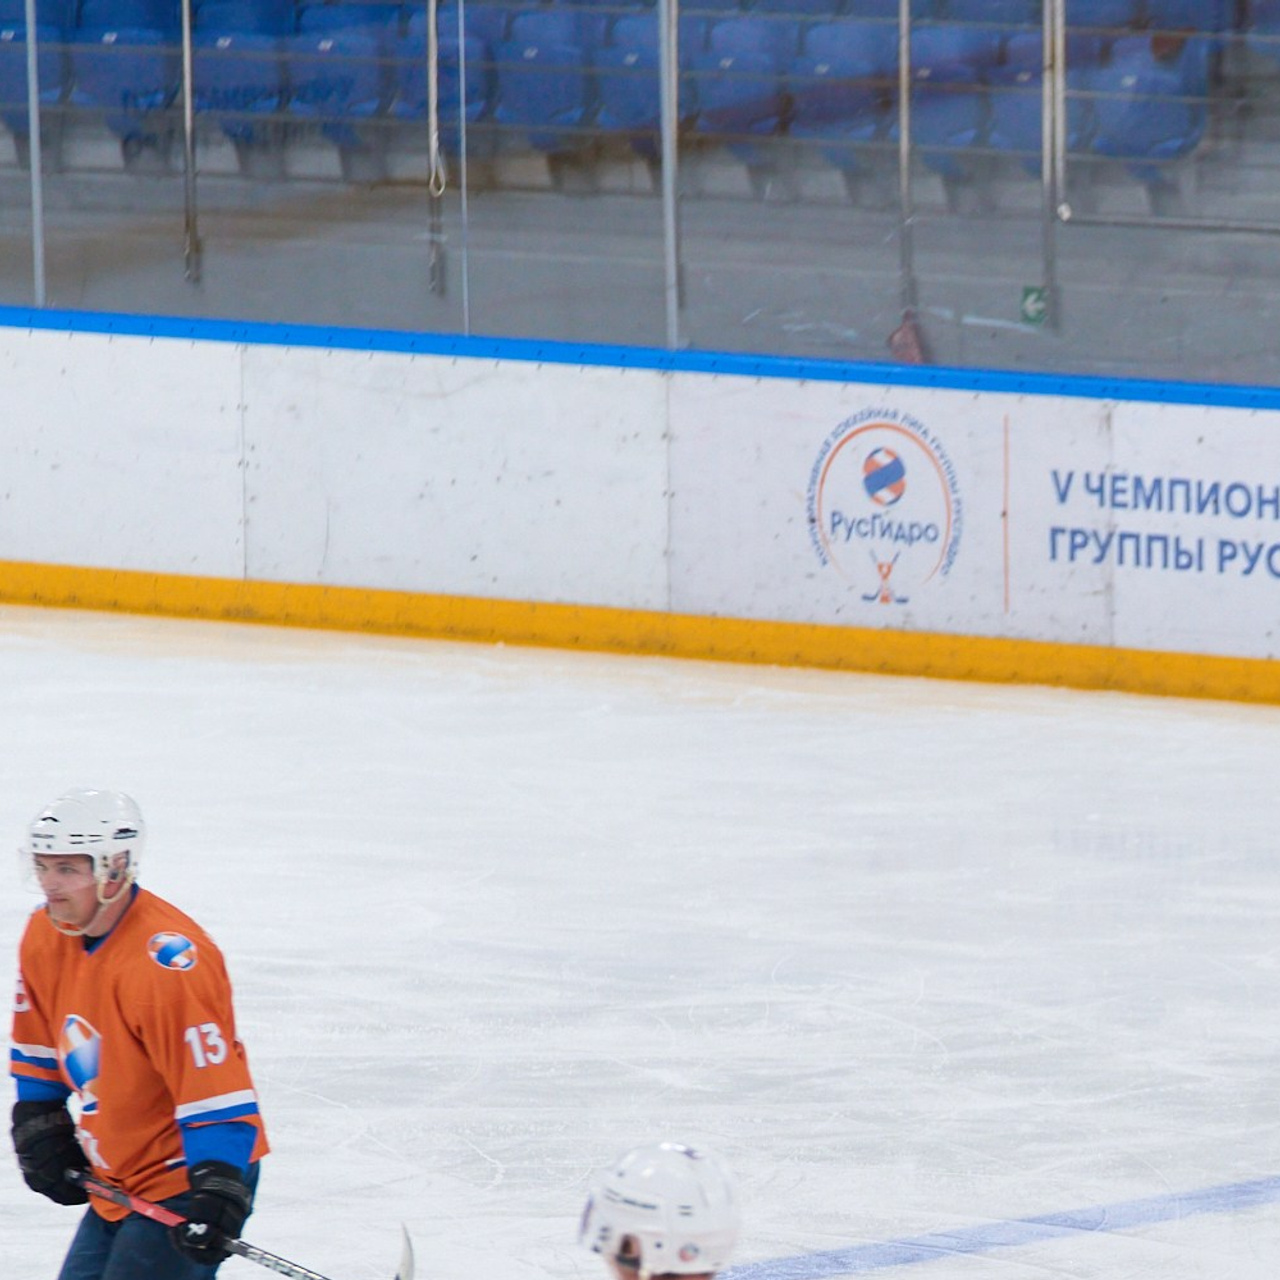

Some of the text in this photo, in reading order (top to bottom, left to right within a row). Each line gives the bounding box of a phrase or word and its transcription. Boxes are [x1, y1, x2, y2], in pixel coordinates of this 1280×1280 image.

[831, 509, 939, 547] РусГидро
[1049, 527, 1204, 573] ГРУППЫ
[184, 1022, 228, 1068] 13
